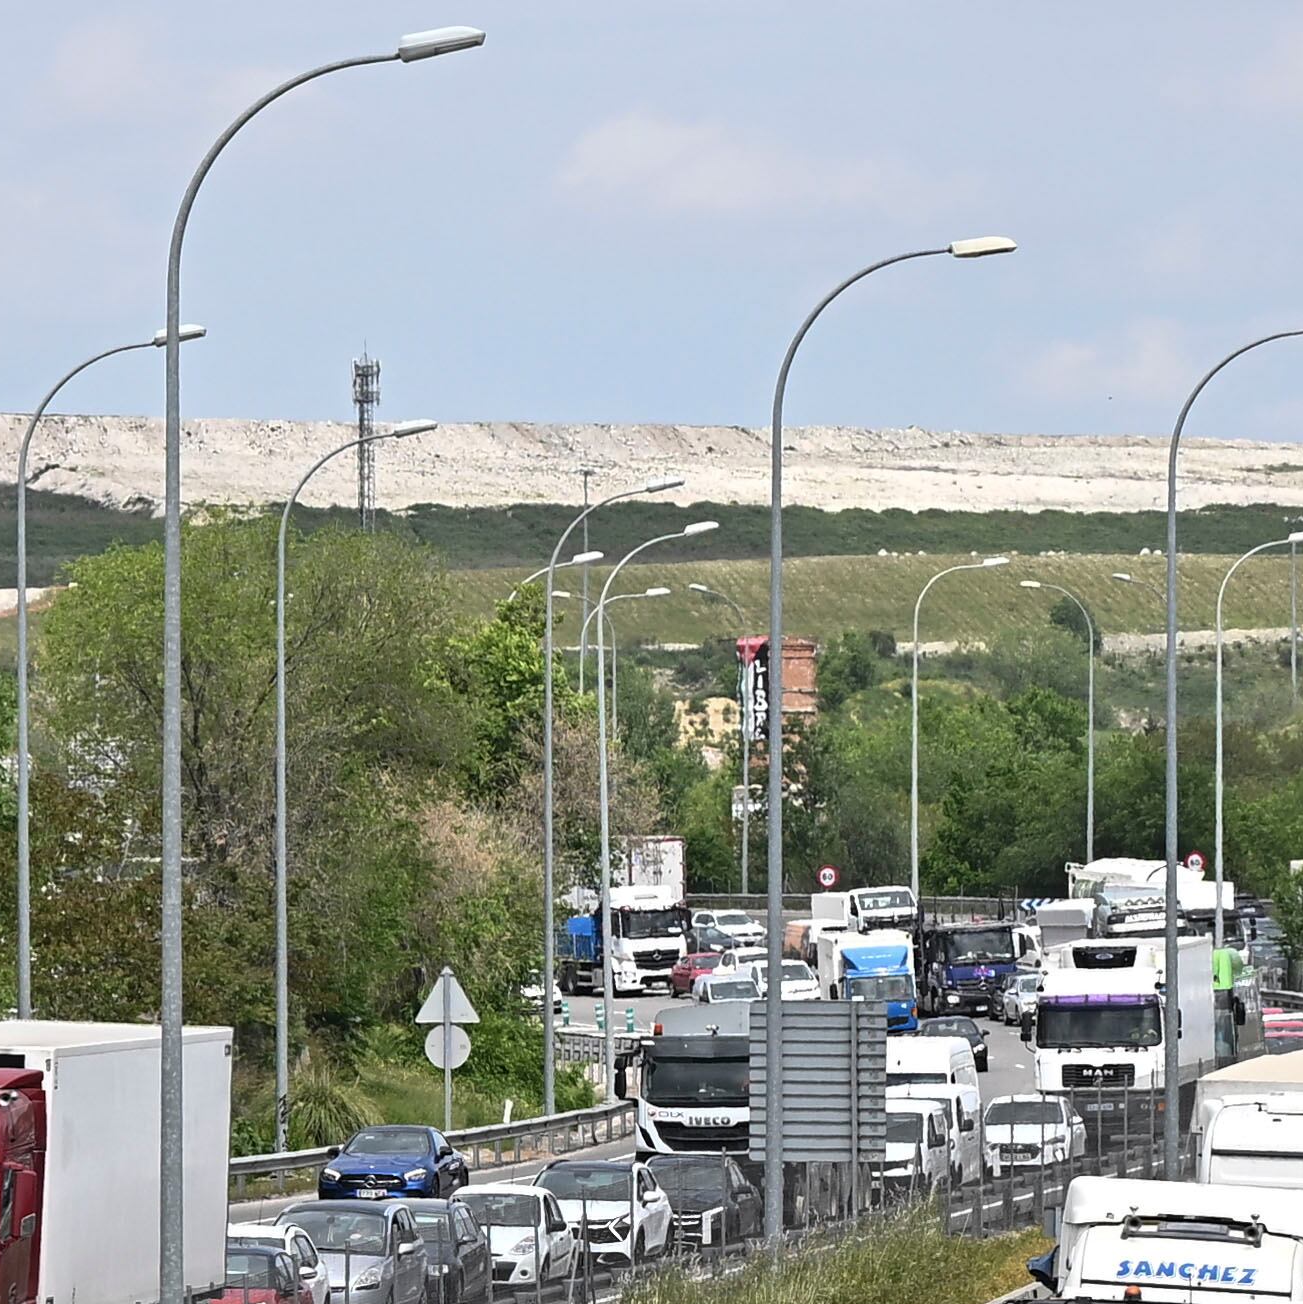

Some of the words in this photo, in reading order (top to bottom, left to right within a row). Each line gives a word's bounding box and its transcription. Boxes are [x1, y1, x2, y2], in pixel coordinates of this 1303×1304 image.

[1082, 1068, 1114, 1077] MAN
[688, 1115, 732, 1126] IVECO
[1116, 1259, 1258, 1286] SANCHEZ
